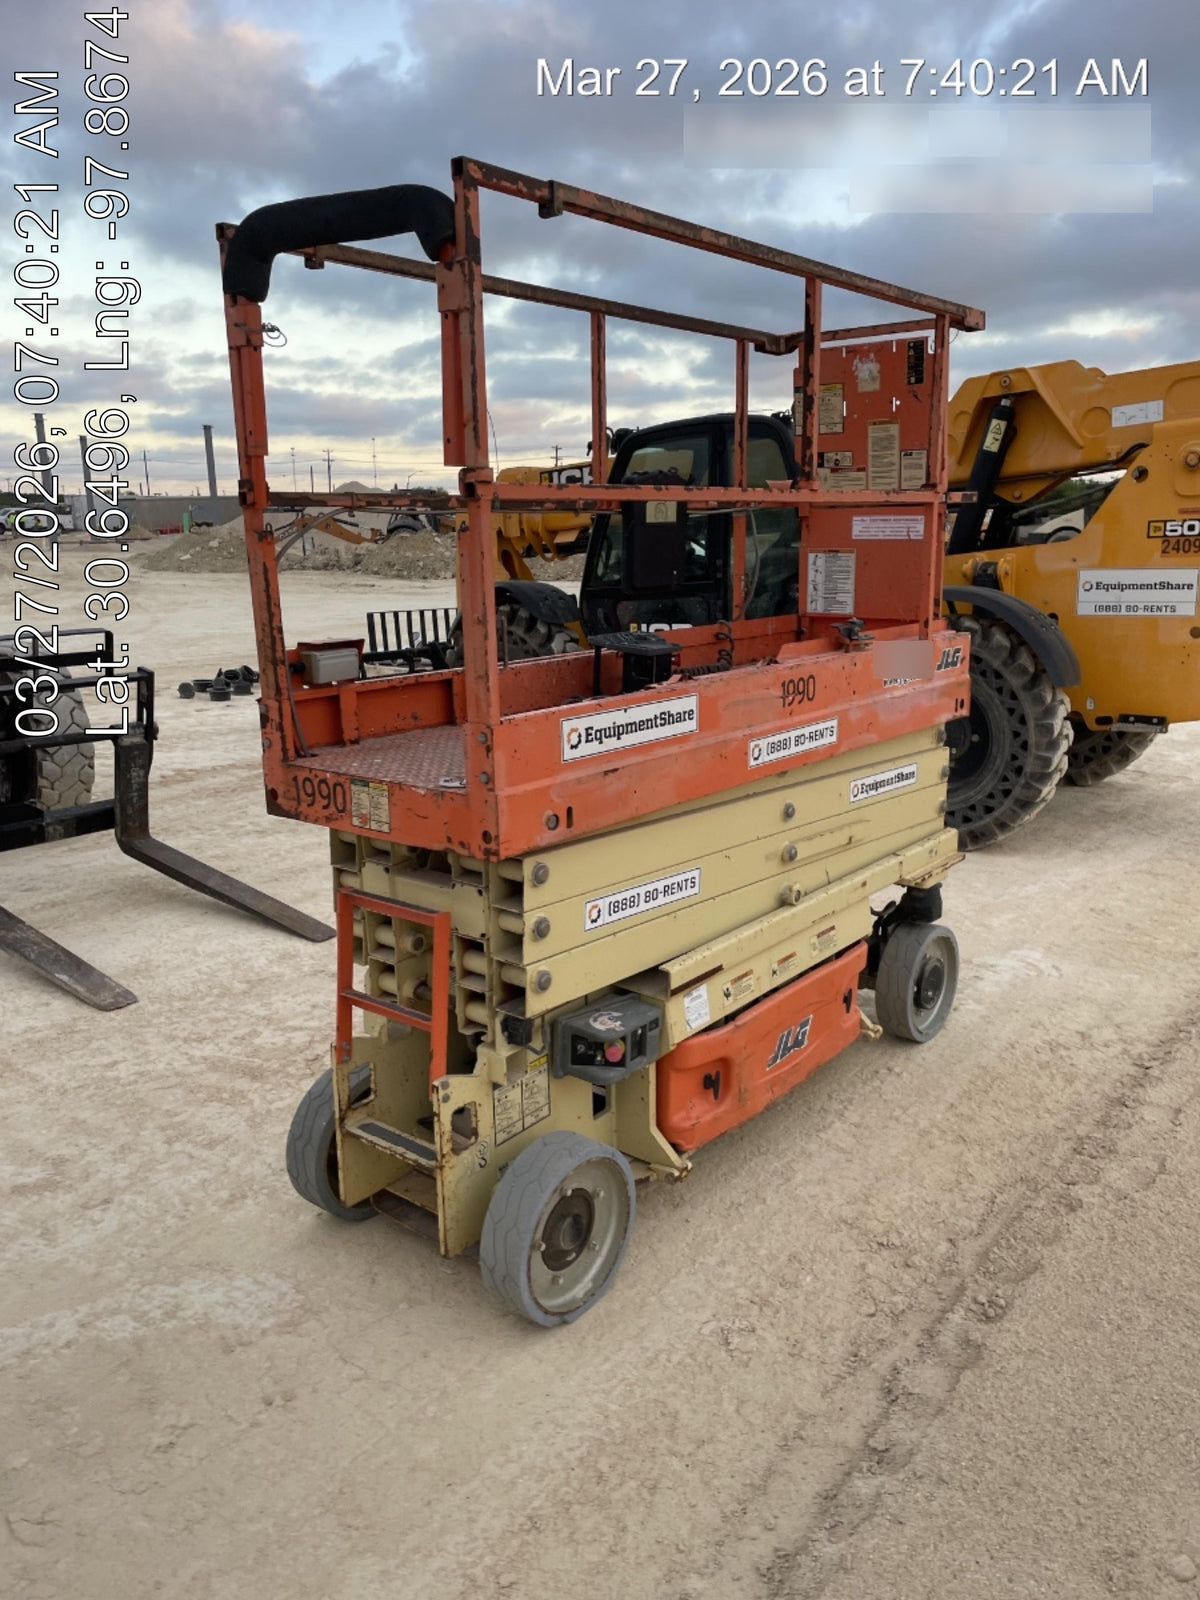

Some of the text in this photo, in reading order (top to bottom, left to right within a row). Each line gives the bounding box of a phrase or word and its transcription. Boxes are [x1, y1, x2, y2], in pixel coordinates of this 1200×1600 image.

[1095, 580, 1194, 593] EquipmentShare
[1094, 604, 1177, 614] (888) 80-RENTS
[936, 646, 962, 671] JLG
[781, 674, 816, 708] 1990
[584, 708, 695, 744] EquipmentShare
[766, 725, 835, 757] (888) 80-RENTS
[292, 775, 348, 814] 1990
[859, 769, 916, 796] EquipmentShare
[608, 876, 697, 917] (888) 80-RENTS
[766, 1014, 813, 1071] JLG
